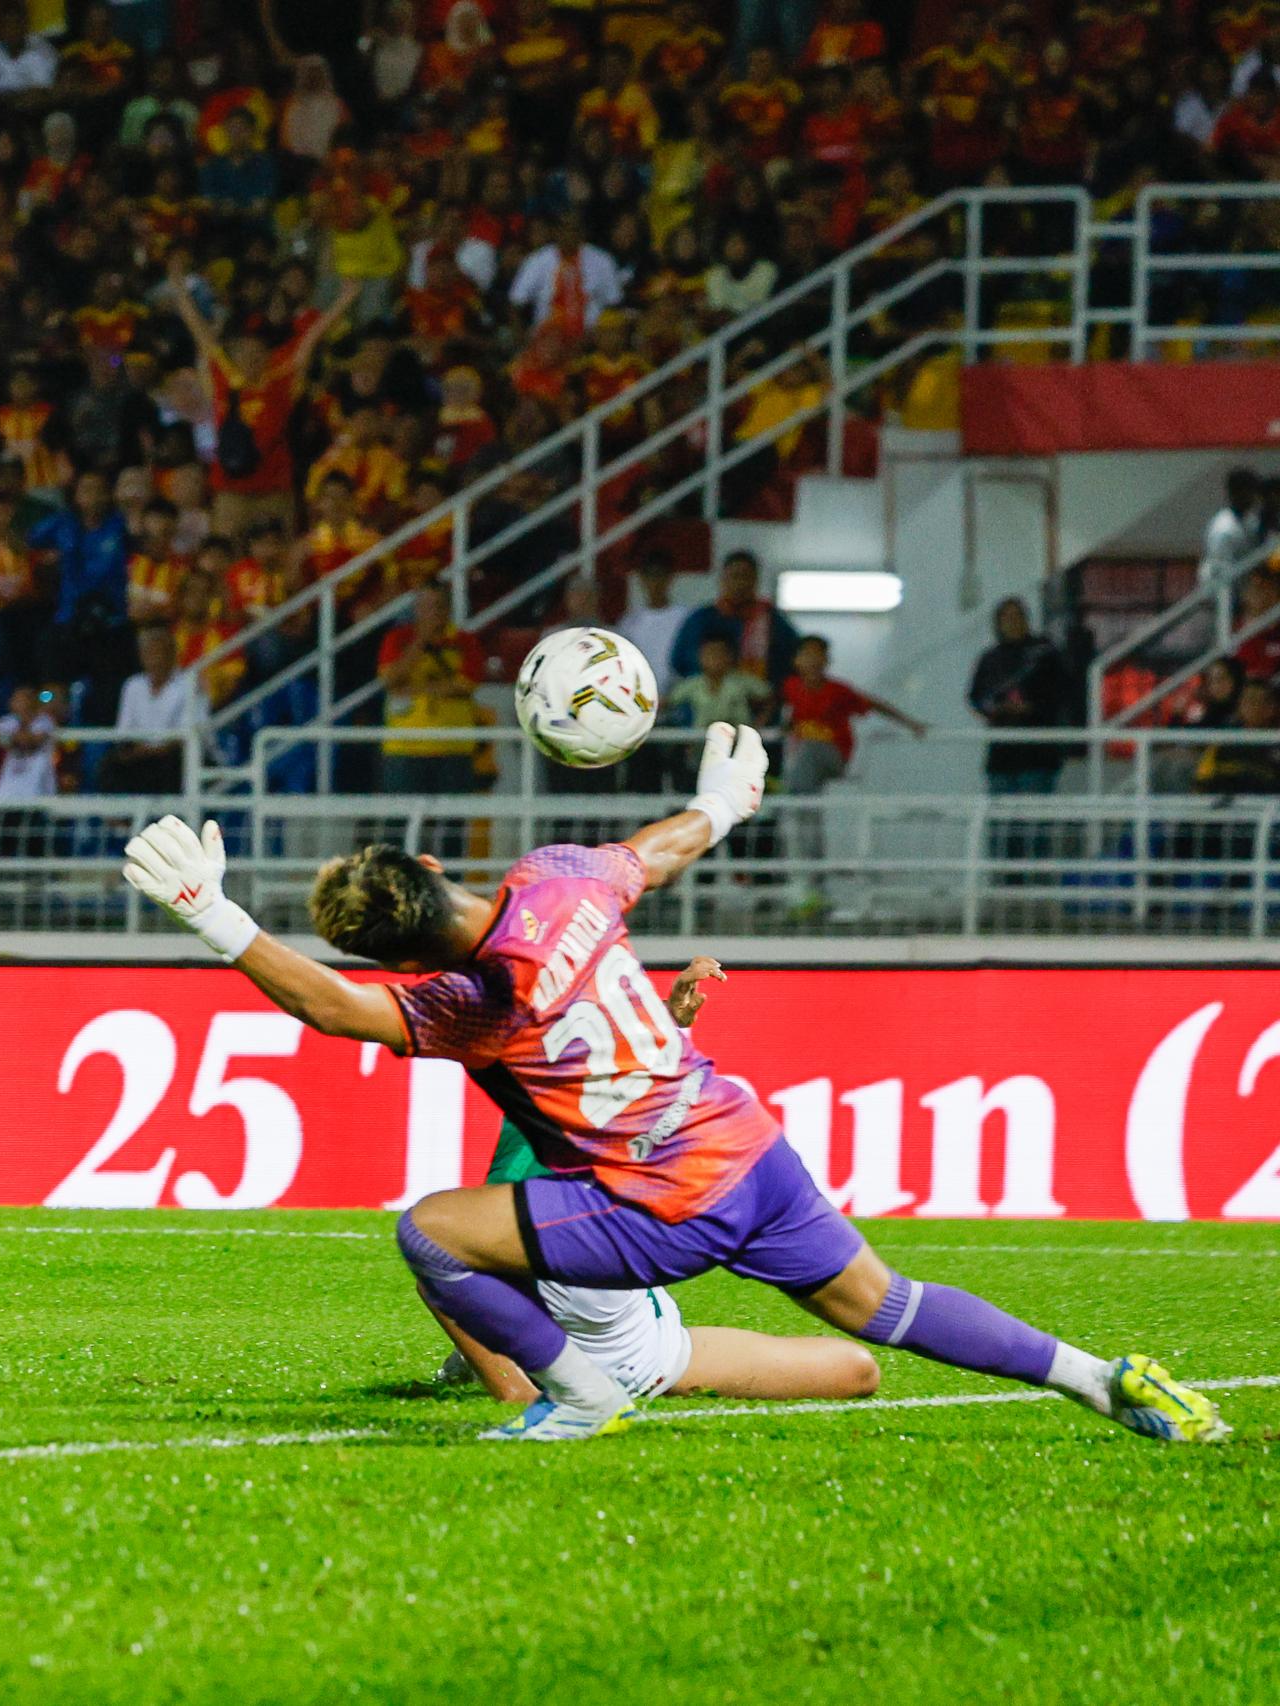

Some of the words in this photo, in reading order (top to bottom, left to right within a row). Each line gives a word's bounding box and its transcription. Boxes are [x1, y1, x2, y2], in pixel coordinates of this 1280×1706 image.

[43, 1008, 303, 1210] 25
[360, 1040, 1067, 1218] Tun
[541, 943, 683, 1129] 20
